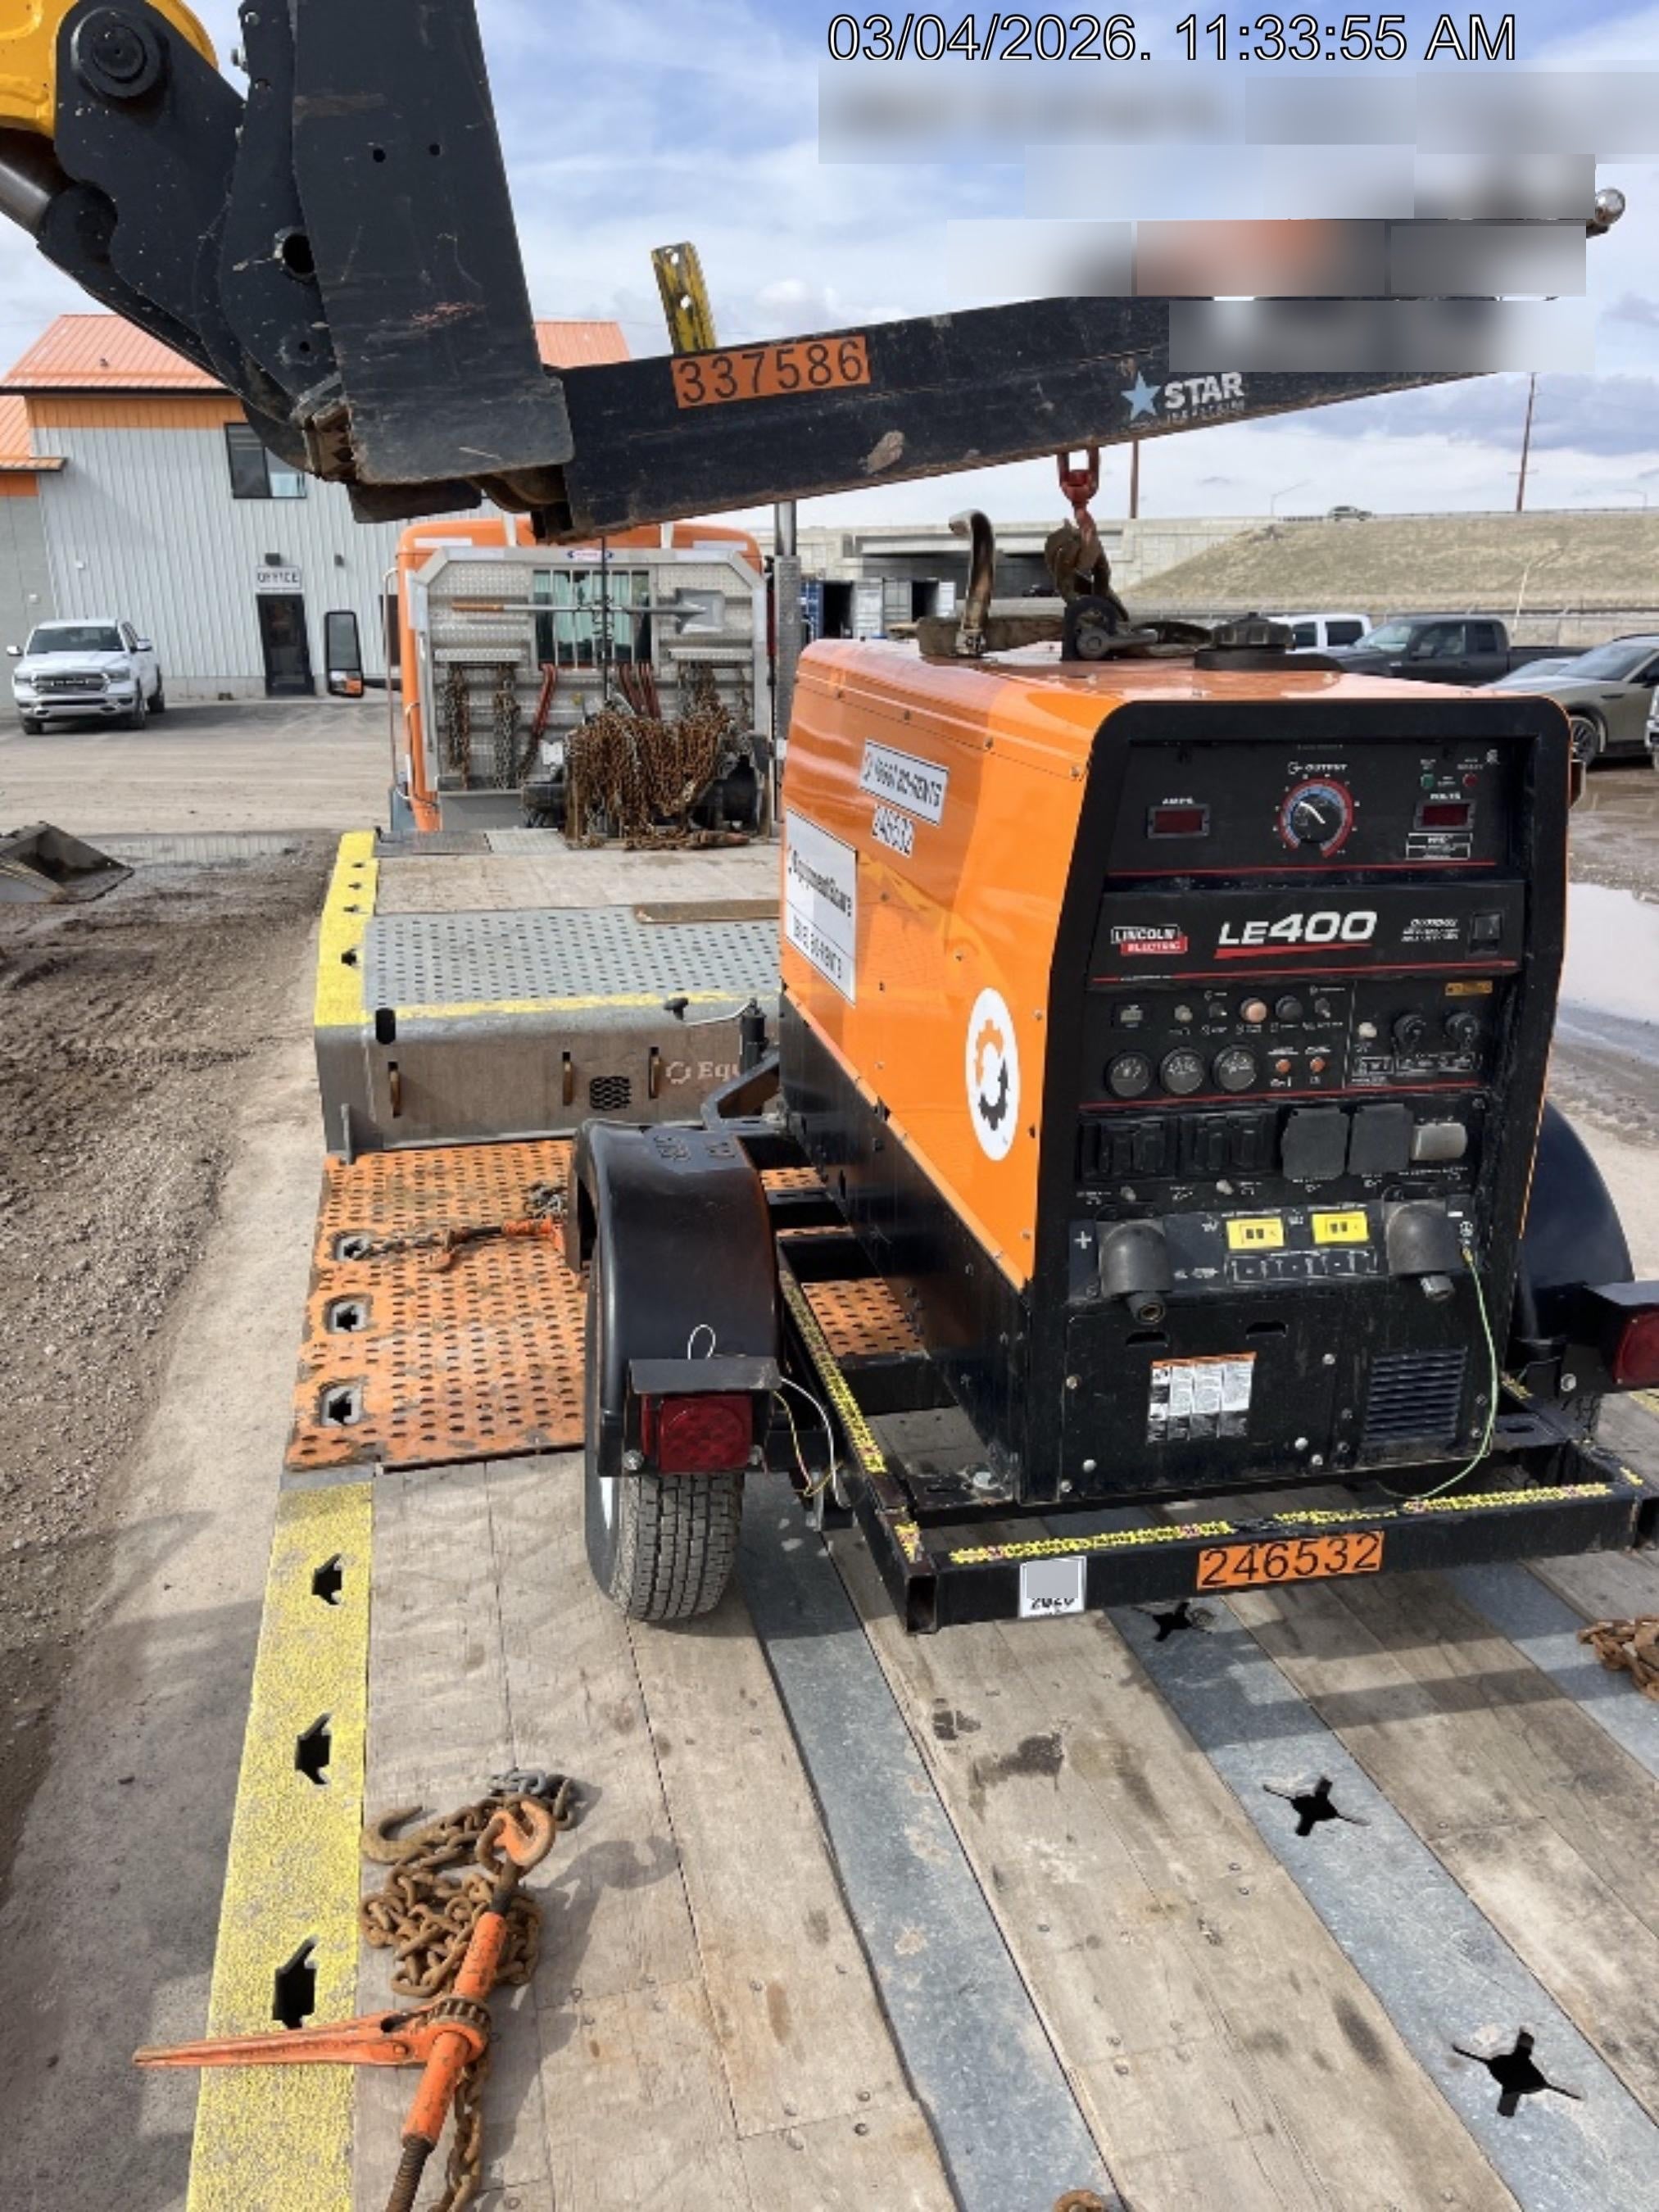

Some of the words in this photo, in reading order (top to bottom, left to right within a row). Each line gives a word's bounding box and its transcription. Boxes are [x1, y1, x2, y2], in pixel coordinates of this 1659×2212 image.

[678, 339, 863, 404] 337586
[1164, 371, 1245, 410] STAR
[257, 571, 300, 583] OFFICE
[1114, 927, 1176, 943] LINCOLN
[1218, 910, 1378, 945] LE400
[1202, 1532, 1380, 1586] 246532
